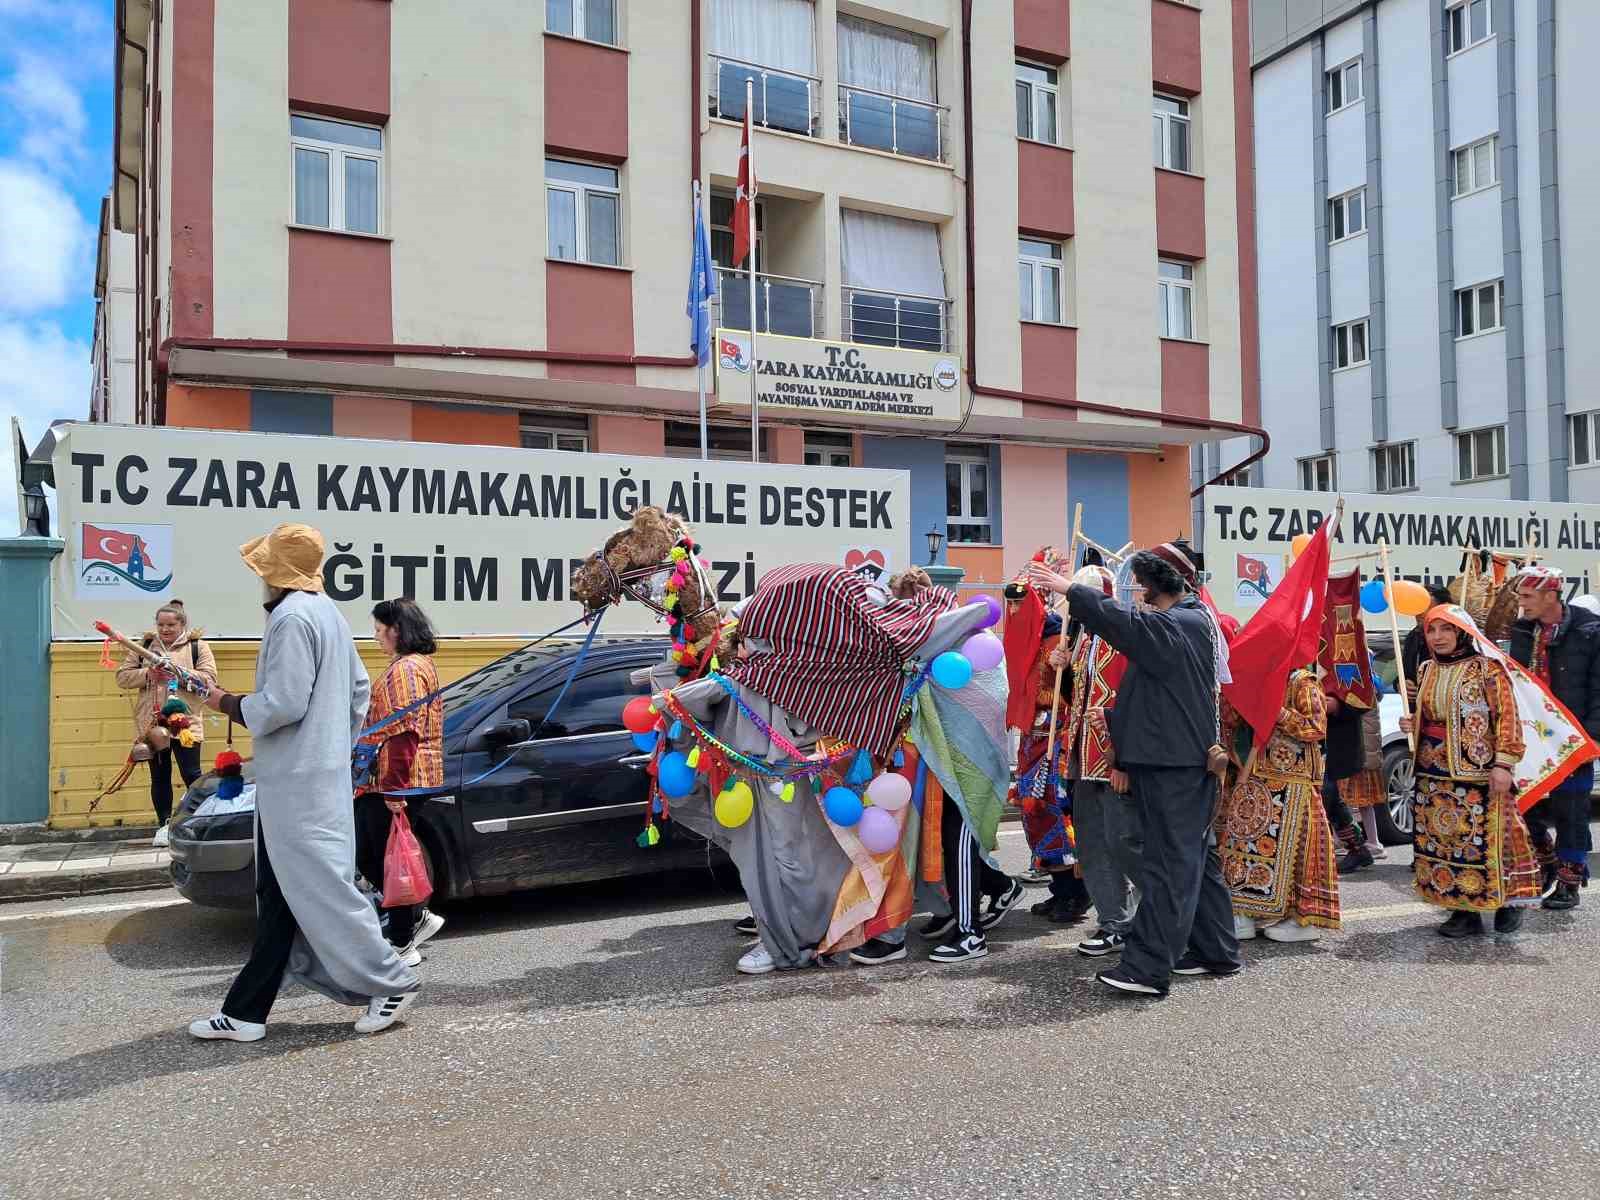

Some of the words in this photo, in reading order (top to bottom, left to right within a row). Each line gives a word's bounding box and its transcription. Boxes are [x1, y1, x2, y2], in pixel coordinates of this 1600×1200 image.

[825, 346, 866, 369] T.C.
[756, 360, 800, 377] ZARA
[803, 364, 932, 390] KAYMAKAMLIĞI
[758, 393, 819, 407] AYANIŞMA
[820, 398, 853, 410] VAKFI
[854, 401, 885, 412] ADEM
[775, 382, 817, 395] SOSYAL
[819, 385, 898, 402] YARDIMLAŞMA
[900, 393, 914, 403] VE
[72, 453, 149, 506] T.C
[166, 457, 300, 509] ZARA
[317, 463, 651, 520] KAYMAKAMLIĞI
[666, 471, 747, 525] AİLE
[760, 485, 893, 529] DESTEK
[1214, 505, 1258, 541] T.C
[1353, 510, 1549, 549] KAYMAKAMLIĞI
[322, 542, 498, 601] ĞİTİM
